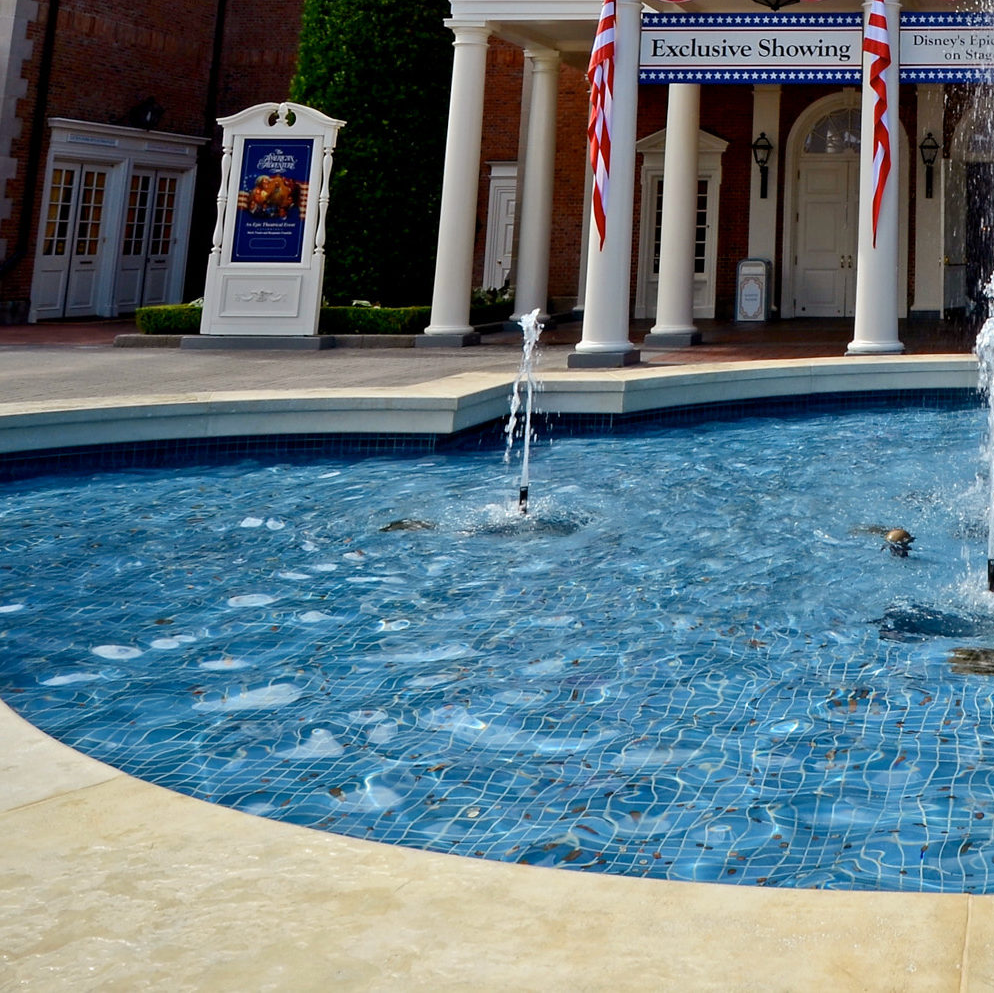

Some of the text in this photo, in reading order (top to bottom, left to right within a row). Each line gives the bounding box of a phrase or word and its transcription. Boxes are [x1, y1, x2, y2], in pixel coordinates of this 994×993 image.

[913, 34, 965, 48] Disney's
[650, 38, 851, 61] Exclusive Showing
[944, 52, 961, 61] on
